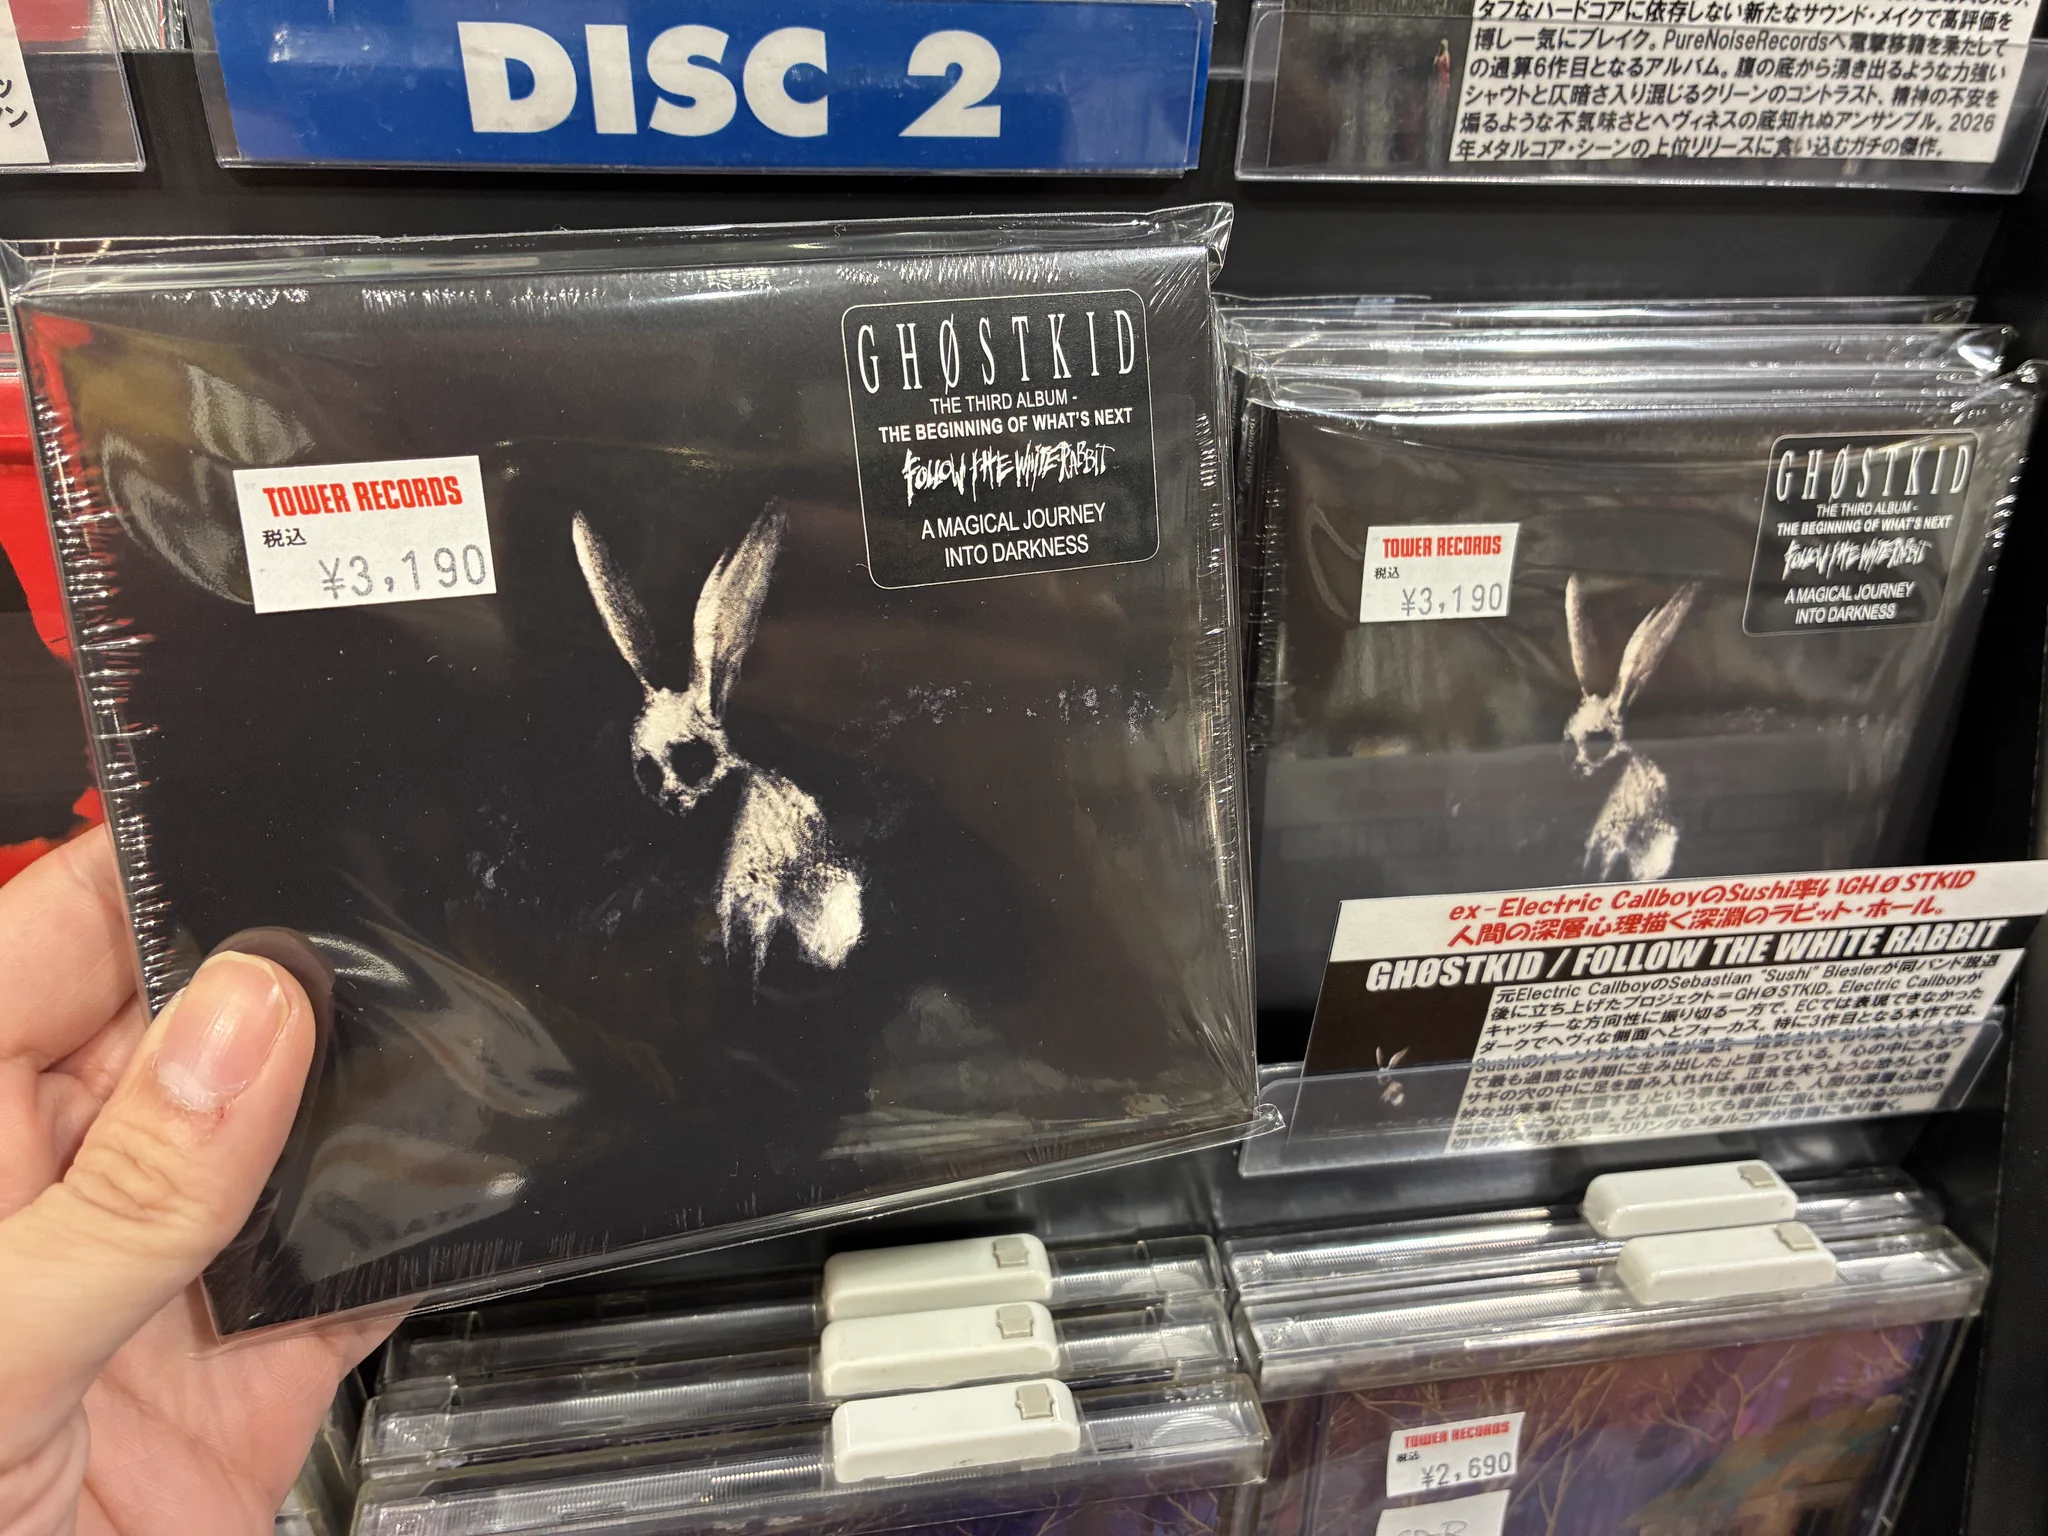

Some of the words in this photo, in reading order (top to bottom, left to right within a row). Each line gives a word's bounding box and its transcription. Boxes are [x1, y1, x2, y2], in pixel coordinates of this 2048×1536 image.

[457, 20, 829, 138] DISC
[898, 29, 1002, 138] 2
[858, 309, 1135, 395] GHØSTKID
[930, 397, 961, 415] THE
[965, 394, 1012, 413] THIRD
[1016, 389, 1068, 409] ALBUM
[878, 425, 911, 443] THE
[915, 418, 1003, 440] BEGINNING
[1007, 415, 1028, 433] OF
[1032, 410, 1090, 430] WHAT'S
[1094, 407, 1133, 426] NEXT
[1776, 444, 1969, 502] GHØSTKID
[263, 483, 352, 517] TOWER
[353, 476, 463, 512] RECORDS
[1816, 503, 1838, 518] THE
[1841, 502, 1873, 517] THIRD
[1873, 500, 1911, 515] ALBUM
[921, 520, 936, 540] A
[937, 512, 1019, 538] MAGICAL
[1023, 502, 1106, 530] JOURNEY
[1777, 522, 1799, 537] THE
[1800, 519, 1861, 535] BEGINNING
[1863, 518, 1879, 532] OF
[1880, 516, 1922, 532] WHAT'S
[1923, 514, 1953, 529] NEXT
[262, 528, 307, 548] 税込
[945, 544, 988, 567] INTO
[992, 534, 1089, 562] DARKNESS
[1382, 537, 1432, 559] TOWER
[1436, 535, 1502, 557] RECORDS
[318, 544, 486, 600] ¥3,190
[1374, 567, 1400, 580] 税込
[1401, 583, 1503, 617] ¥3,190
[1784, 588, 1798, 604] A
[1797, 584, 1853, 603] MAGICAL
[1855, 581, 1915, 599] JOURNEY
[1795, 607, 1826, 624] INTO
[1828, 603, 1896, 622] DARKNESS
[1448, 892, 1603, 921] ex-Electric
[1365, 950, 1548, 992] GHØSTKID
[1571, 937, 1706, 977] FOLLOW
[1709, 935, 1774, 966] THE
[1773, 927, 1892, 963] WHITE
[1882, 918, 2011, 957] RABBIT
[1497, 984, 1581, 1005] 元Electric
[1588, 969, 1751, 997] CallboyのSebastian
[1404, 1431, 1448, 1449] TOWER
[1452, 1421, 1510, 1441] RECORDS
[1421, 1451, 1512, 1487] ¥2,690
